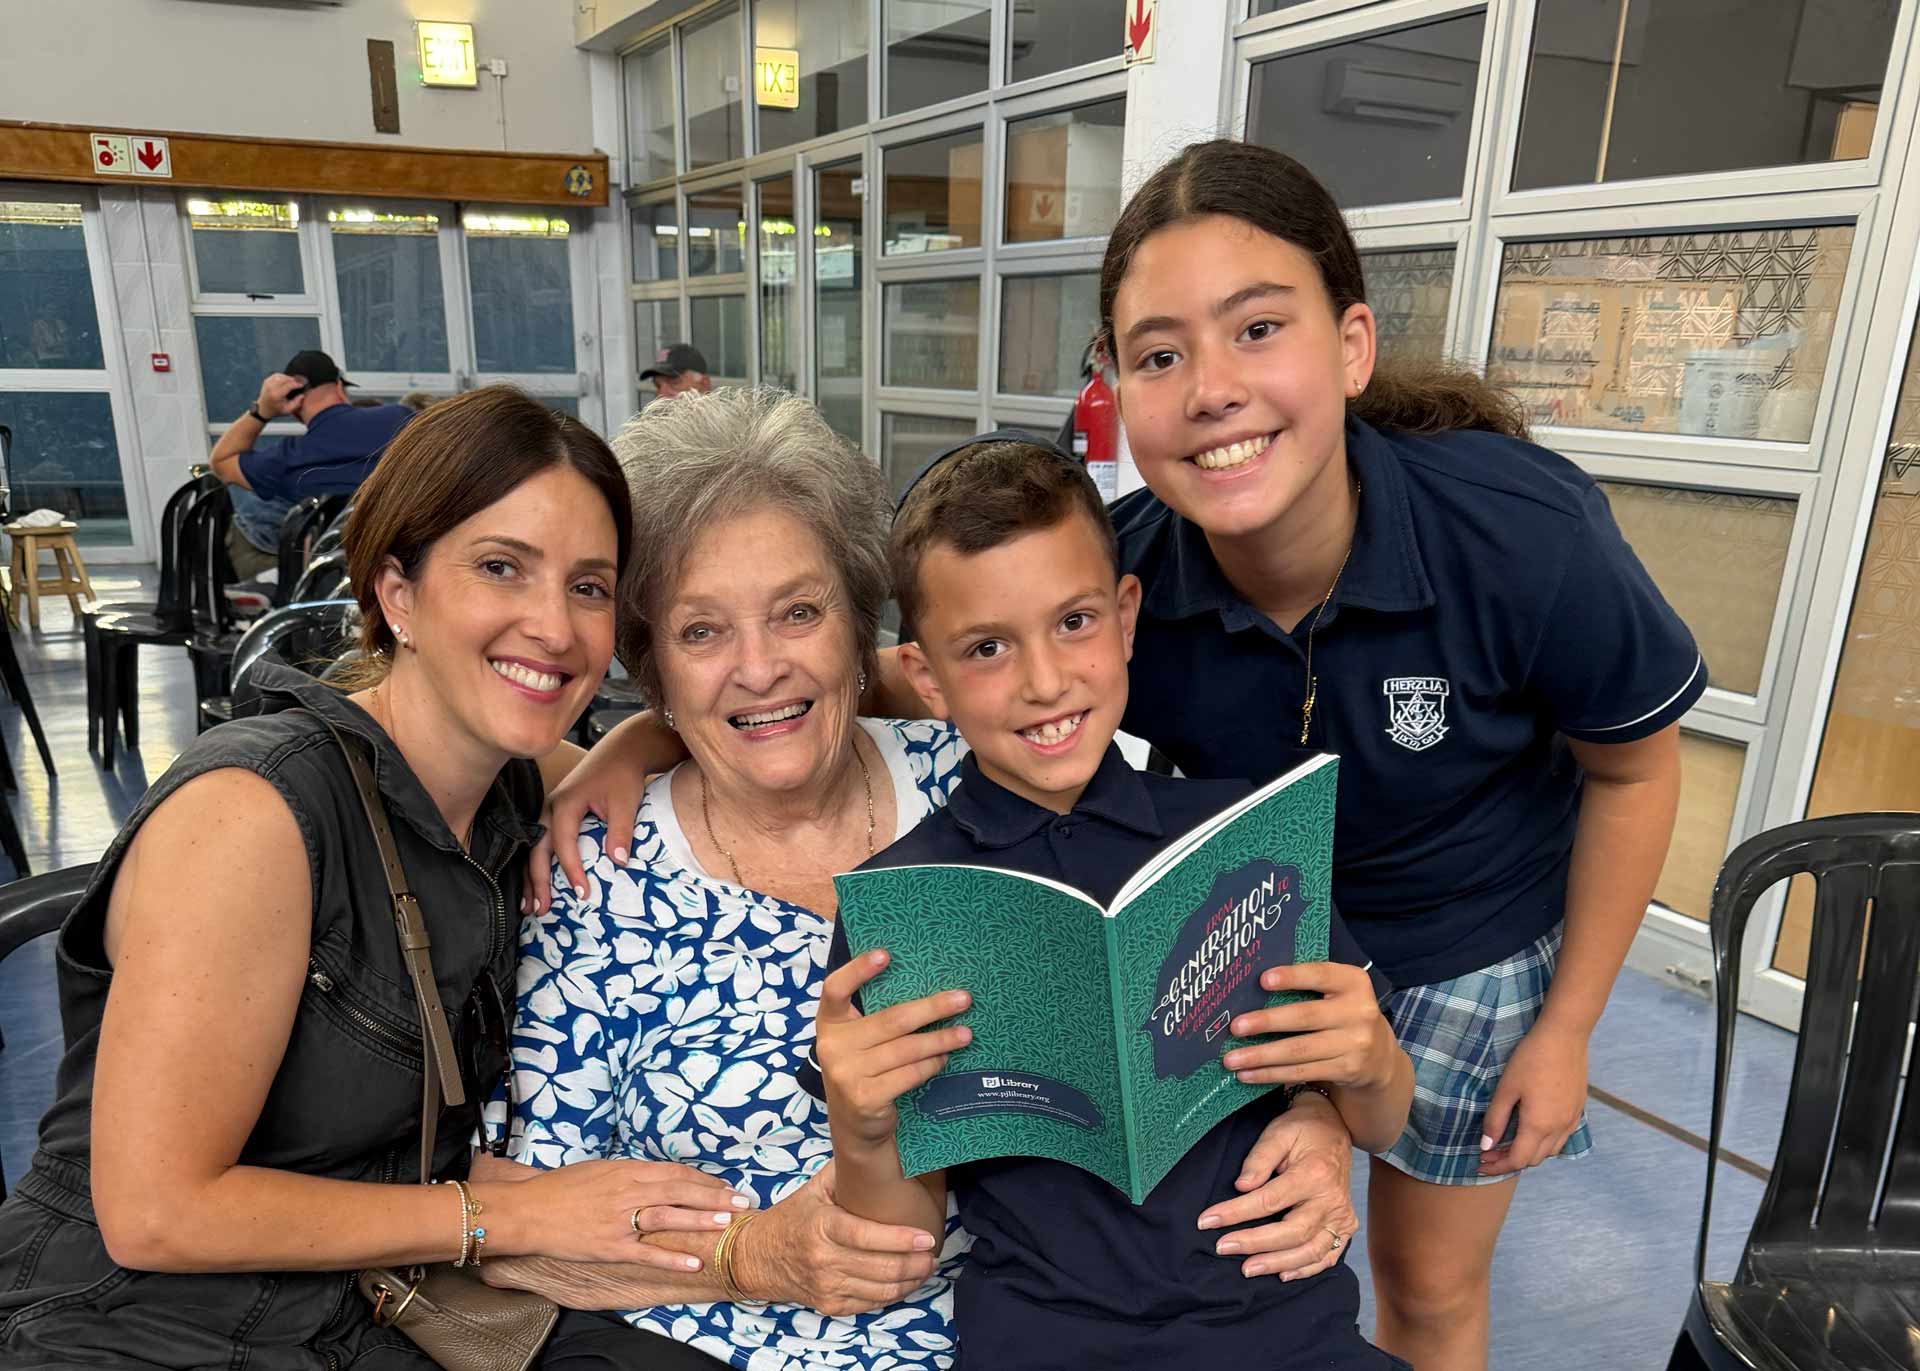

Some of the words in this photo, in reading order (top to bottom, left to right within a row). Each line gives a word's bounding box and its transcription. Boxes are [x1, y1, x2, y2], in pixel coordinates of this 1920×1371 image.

[1390, 681, 1444, 691] HERZLIA
[1204, 896, 1234, 935] FROM
[1152, 872, 1275, 1021] GENERATION
[1164, 893, 1291, 1036] GENERATION
[1223, 955, 1244, 980] FOR
[1191, 963, 1253, 1033] GRANDCHILD
[977, 1090, 1050, 1102] www.pjlibrary.org
[983, 1077, 1000, 1088] PJ
[1001, 1078, 1040, 1090] Library
